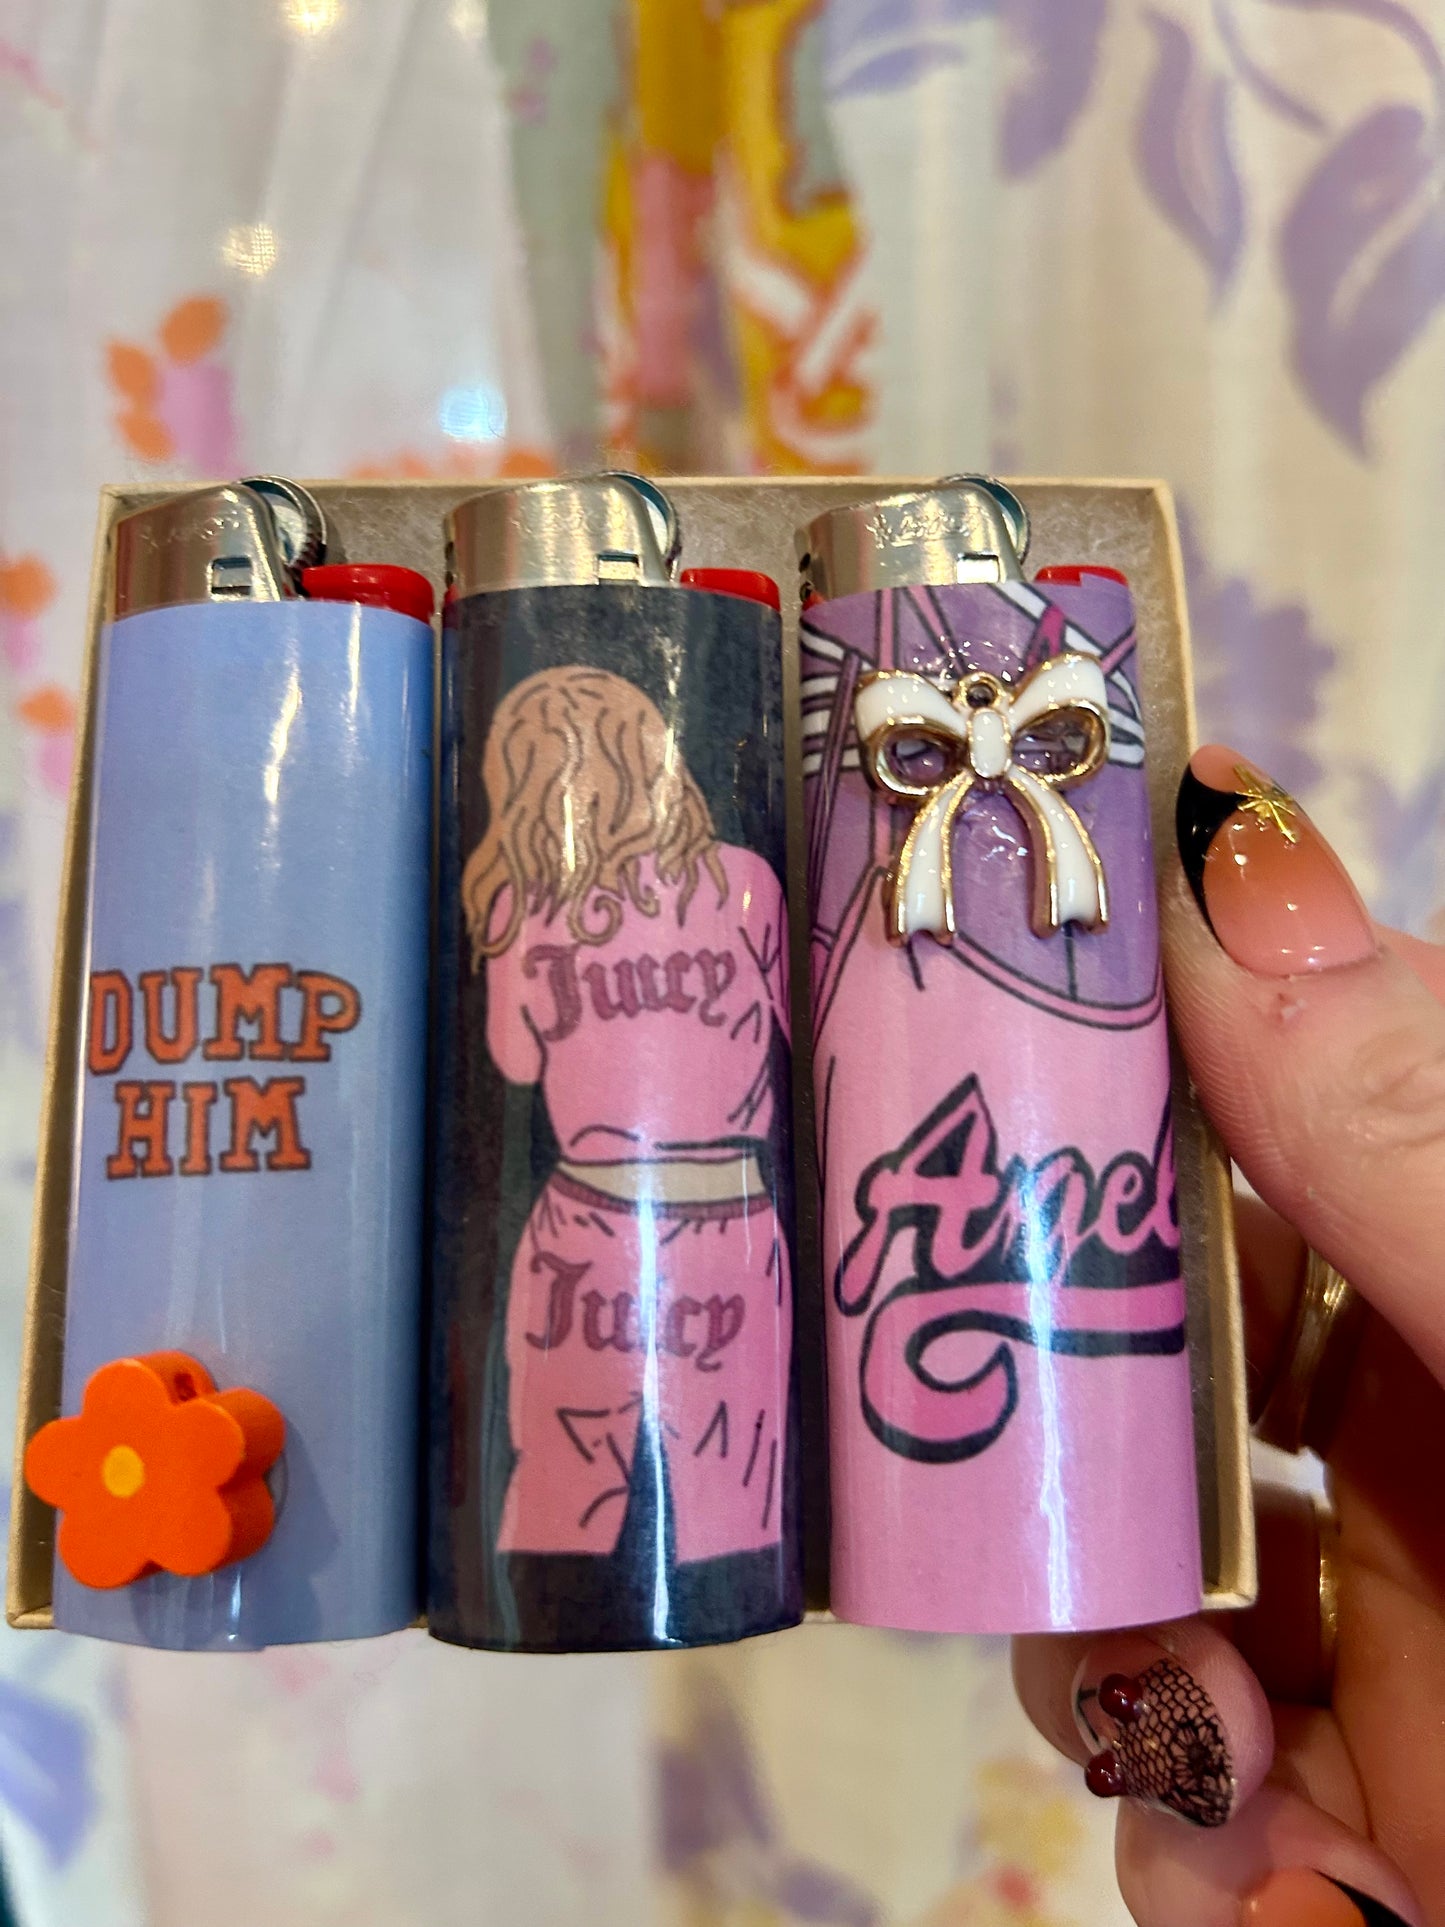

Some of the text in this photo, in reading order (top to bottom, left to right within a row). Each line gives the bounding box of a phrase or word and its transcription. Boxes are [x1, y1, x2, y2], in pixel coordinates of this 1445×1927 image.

[88, 963, 362, 1075] DUMP
[522, 944, 737, 1043] Juicy
[107, 1075, 312, 1180] HIM
[524, 1250, 746, 1373] Jucy
